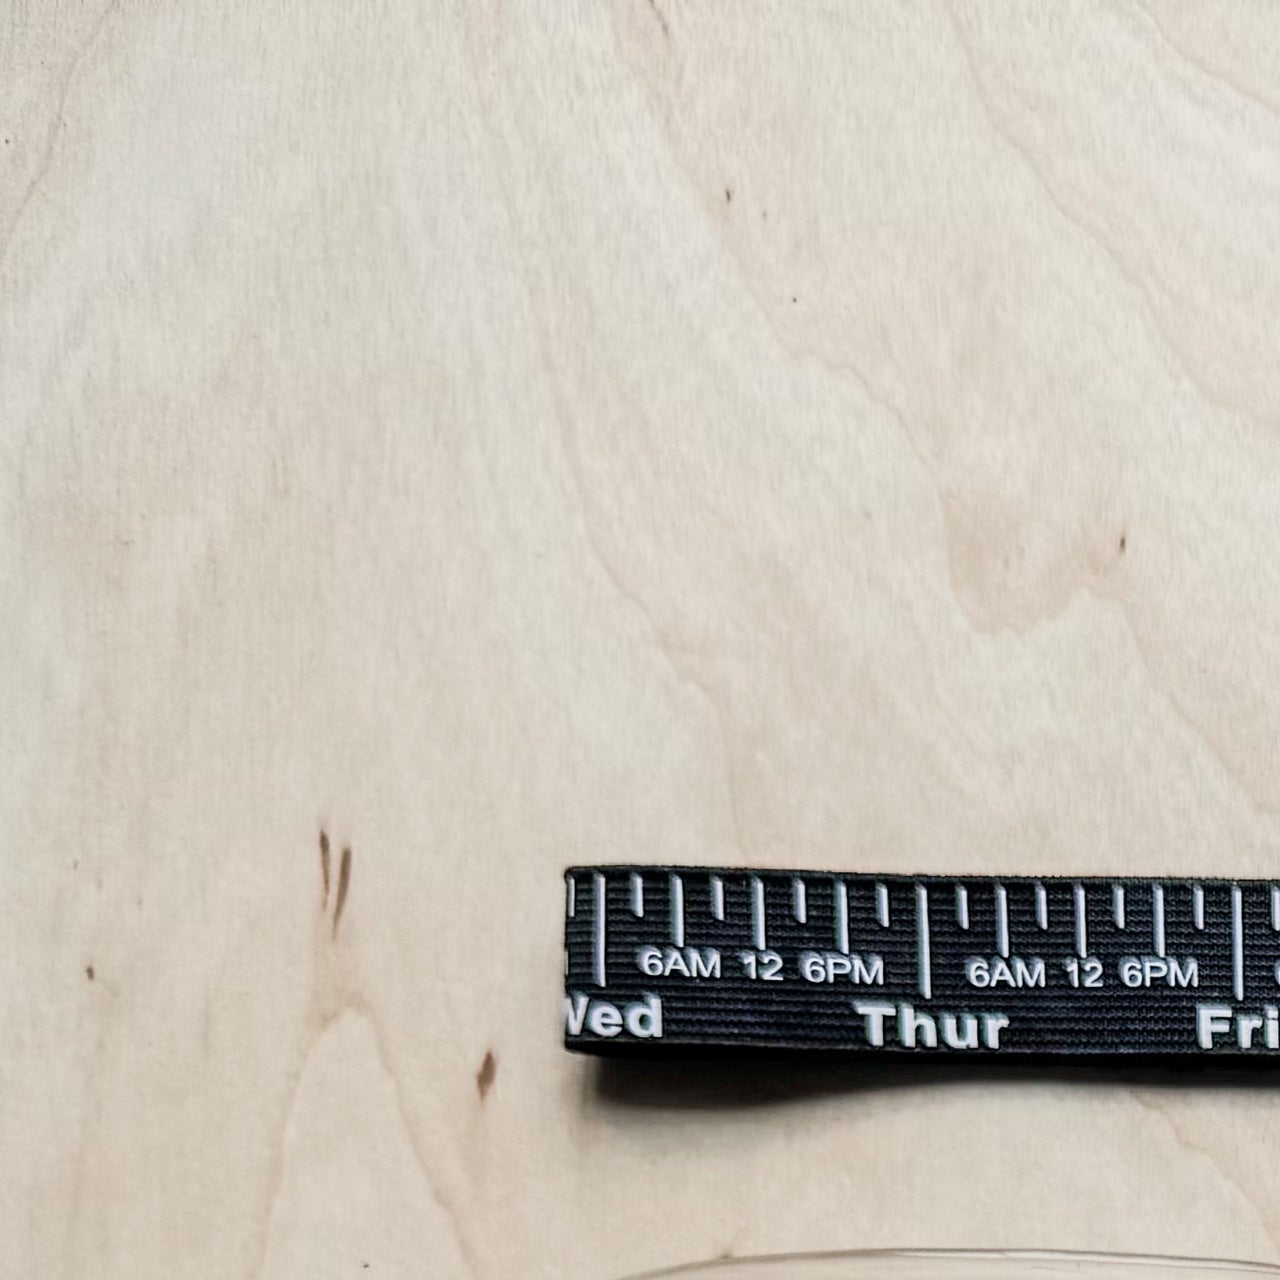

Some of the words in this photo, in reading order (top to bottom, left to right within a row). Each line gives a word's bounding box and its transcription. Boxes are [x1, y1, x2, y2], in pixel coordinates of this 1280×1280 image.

[639, 948, 720, 979] 6AM
[742, 953, 783, 981] 12
[800, 953, 884, 985] 6PM
[966, 960, 1046, 989] 6AM
[1065, 962, 1104, 989] 12
[1120, 959, 1200, 989] 6PM
[854, 1001, 1010, 1049] Thur
[1196, 1003, 1280, 1048] Fri
